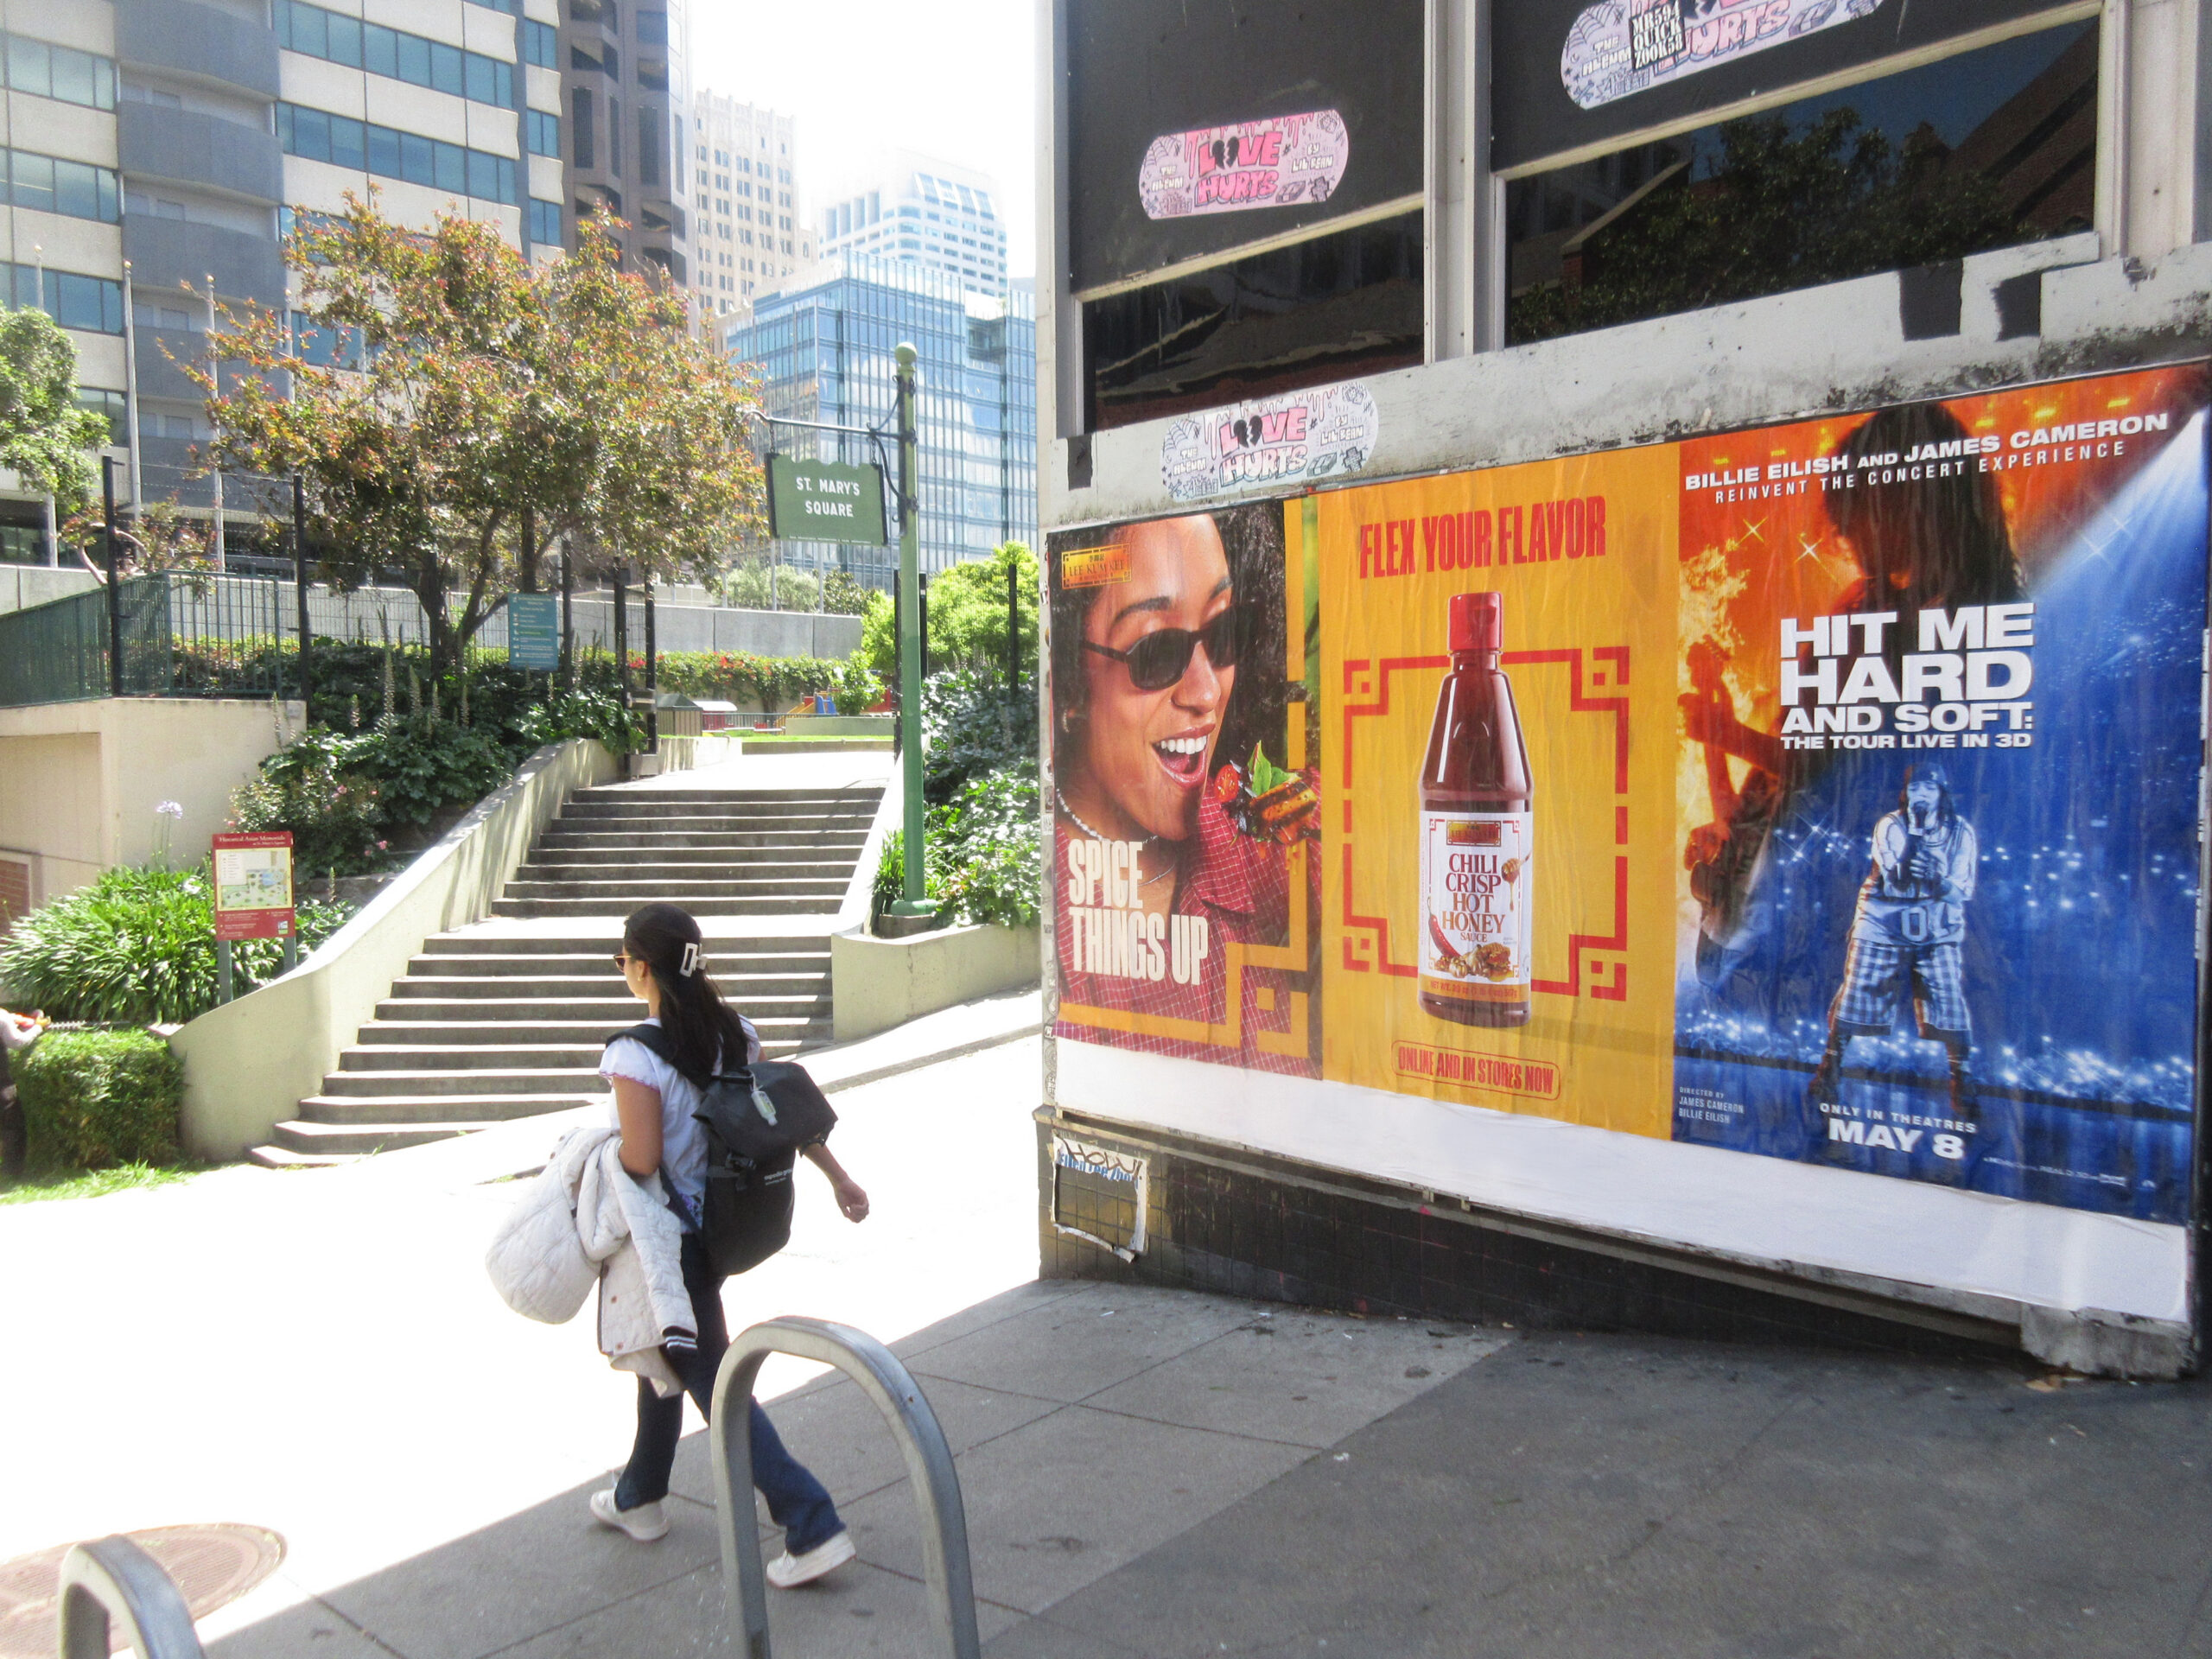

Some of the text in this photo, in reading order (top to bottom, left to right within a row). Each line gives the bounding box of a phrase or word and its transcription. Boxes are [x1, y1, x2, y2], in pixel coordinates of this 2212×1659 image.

[1631, 2, 1681, 36] MR594
[1633, 16, 1681, 52] QUICK
[1593, 35, 1619, 54] THE
[1194, 170, 1280, 207] HURTS
[1221, 445, 1307, 487] HURTS
[1686, 413, 2168, 491] BILLIE EILISH AND JAMES CAMERON
[797, 477, 861, 496] ST. MARY'S
[1715, 441, 2125, 504] REINVENT THE CONCERT EXPERIENCE
[805, 500, 854, 517] SQUARE
[1360, 495, 1606, 579] FLEX YOUR FLAVOR
[1069, 565, 1083, 577] LEE
[1781, 602, 2035, 658] HIT ME
[1781, 650, 2033, 706] HARD
[1781, 701, 2034, 734] AND SOFT:
[1781, 733, 2031, 749] THE TOUR LIVE IN 3D
[1068, 838, 1144, 910] SPICE
[1448, 853, 1498, 874] CHILI
[1446, 873, 1502, 894] CRISP
[1452, 893, 1494, 913] HOT
[1442, 911, 1506, 934] HONEY
[1460, 931, 1488, 943] SAUCE
[1069, 906, 1209, 986] THINGS UP
[1398, 1046, 1554, 1094] ONLINE AND IN STORES NOW
[1679, 1108, 1730, 1124] BILLIE EILISH
[1680, 1096, 1745, 1114] JAMES CAMERON
[1820, 1103, 1978, 1134] ONLY IN THEATRES
[1829, 1117, 1966, 1160] MAY 8
